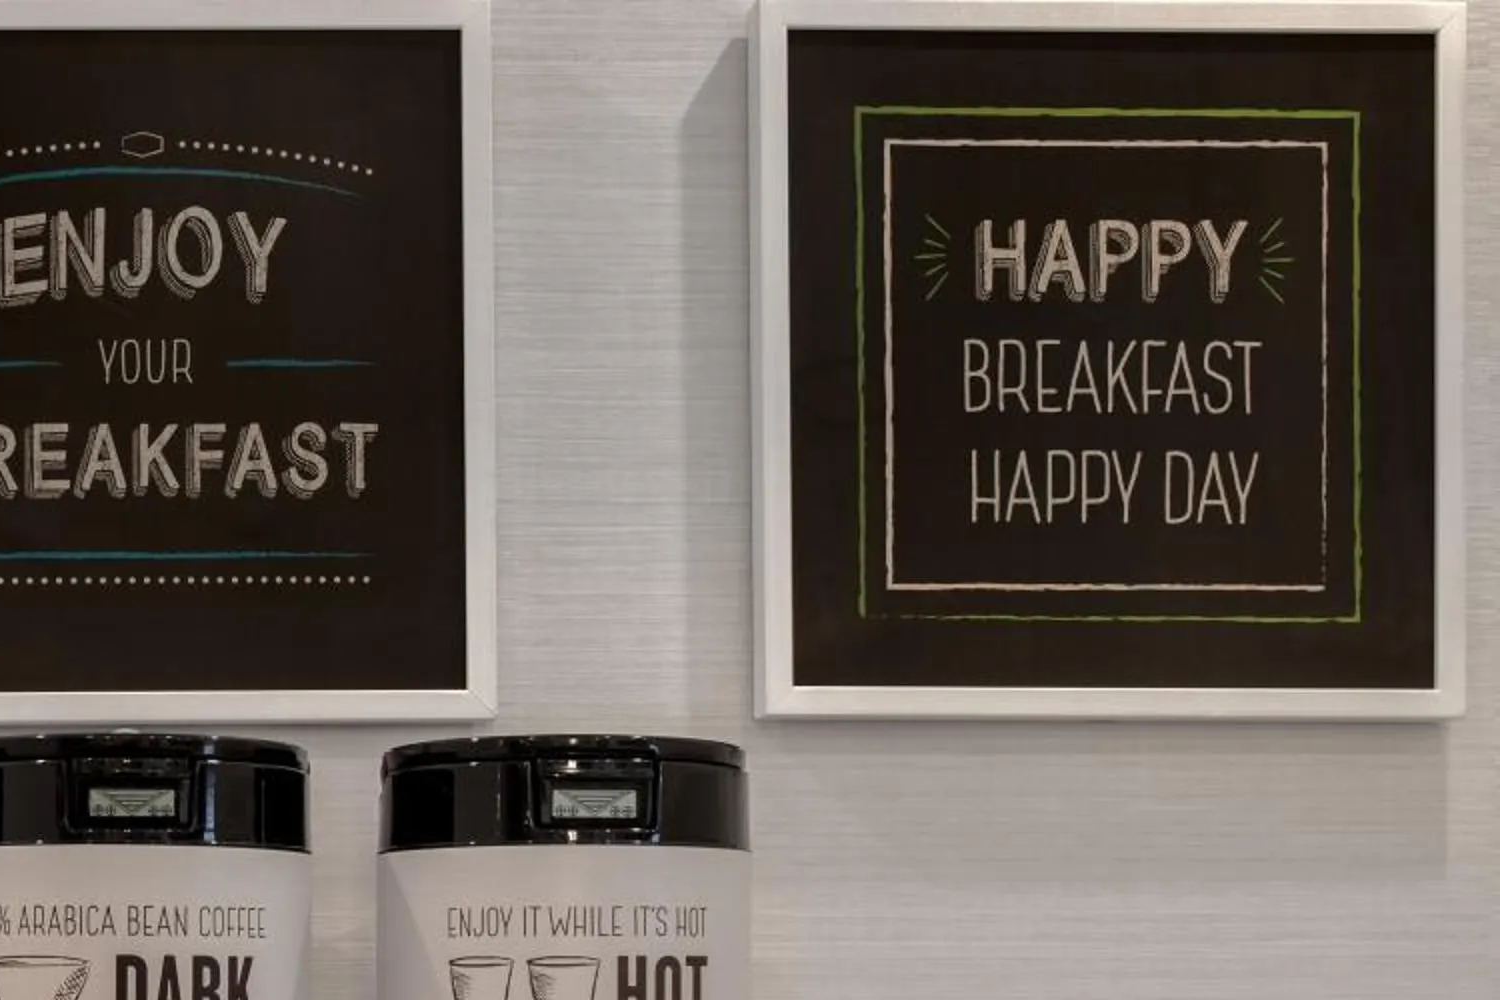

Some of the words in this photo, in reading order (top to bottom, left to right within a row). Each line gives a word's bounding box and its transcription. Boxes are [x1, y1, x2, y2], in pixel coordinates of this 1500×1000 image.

[974, 218, 1249, 303] HAPPY
[97, 338, 193, 385] YOUR
[962, 339, 1262, 416] BREAKFAST
[970, 449, 1143, 525] HAPPY
[1164, 450, 1259, 525] DAY
[17, 905, 117, 938] ARABICA
[127, 905, 188, 938] BEAN
[199, 906, 266, 939] COFFEE
[447, 906, 513, 938] ENJOY
[522, 906, 542, 938] IT
[548, 906, 624, 938] WHILE
[633, 906, 668, 938] IT'S
[675, 906, 708, 938] HOT
